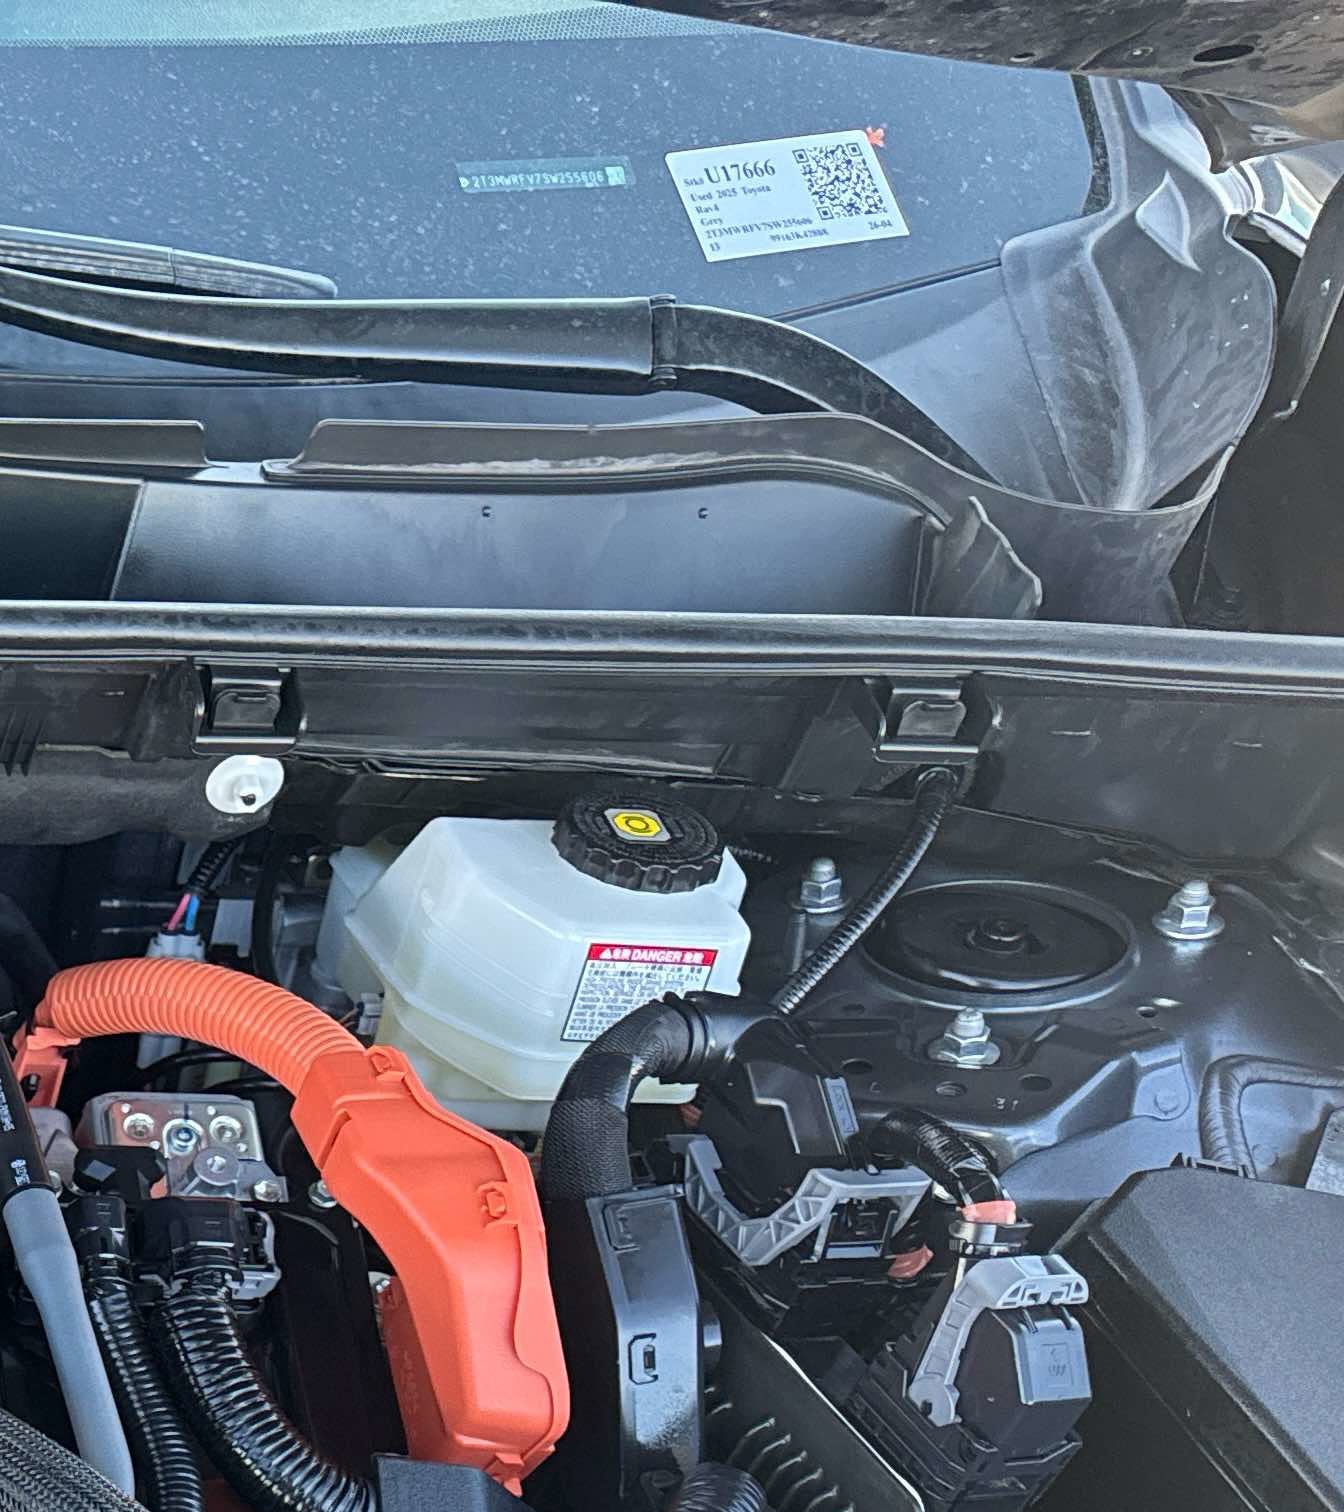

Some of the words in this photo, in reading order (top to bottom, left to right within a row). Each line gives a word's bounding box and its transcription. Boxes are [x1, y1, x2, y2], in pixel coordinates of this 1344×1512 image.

[704, 158, 776, 184] U17666
[690, 191, 713, 203] Used
[742, 184, 772, 197] Toyota
[631, 949, 682, 963] DANGER
